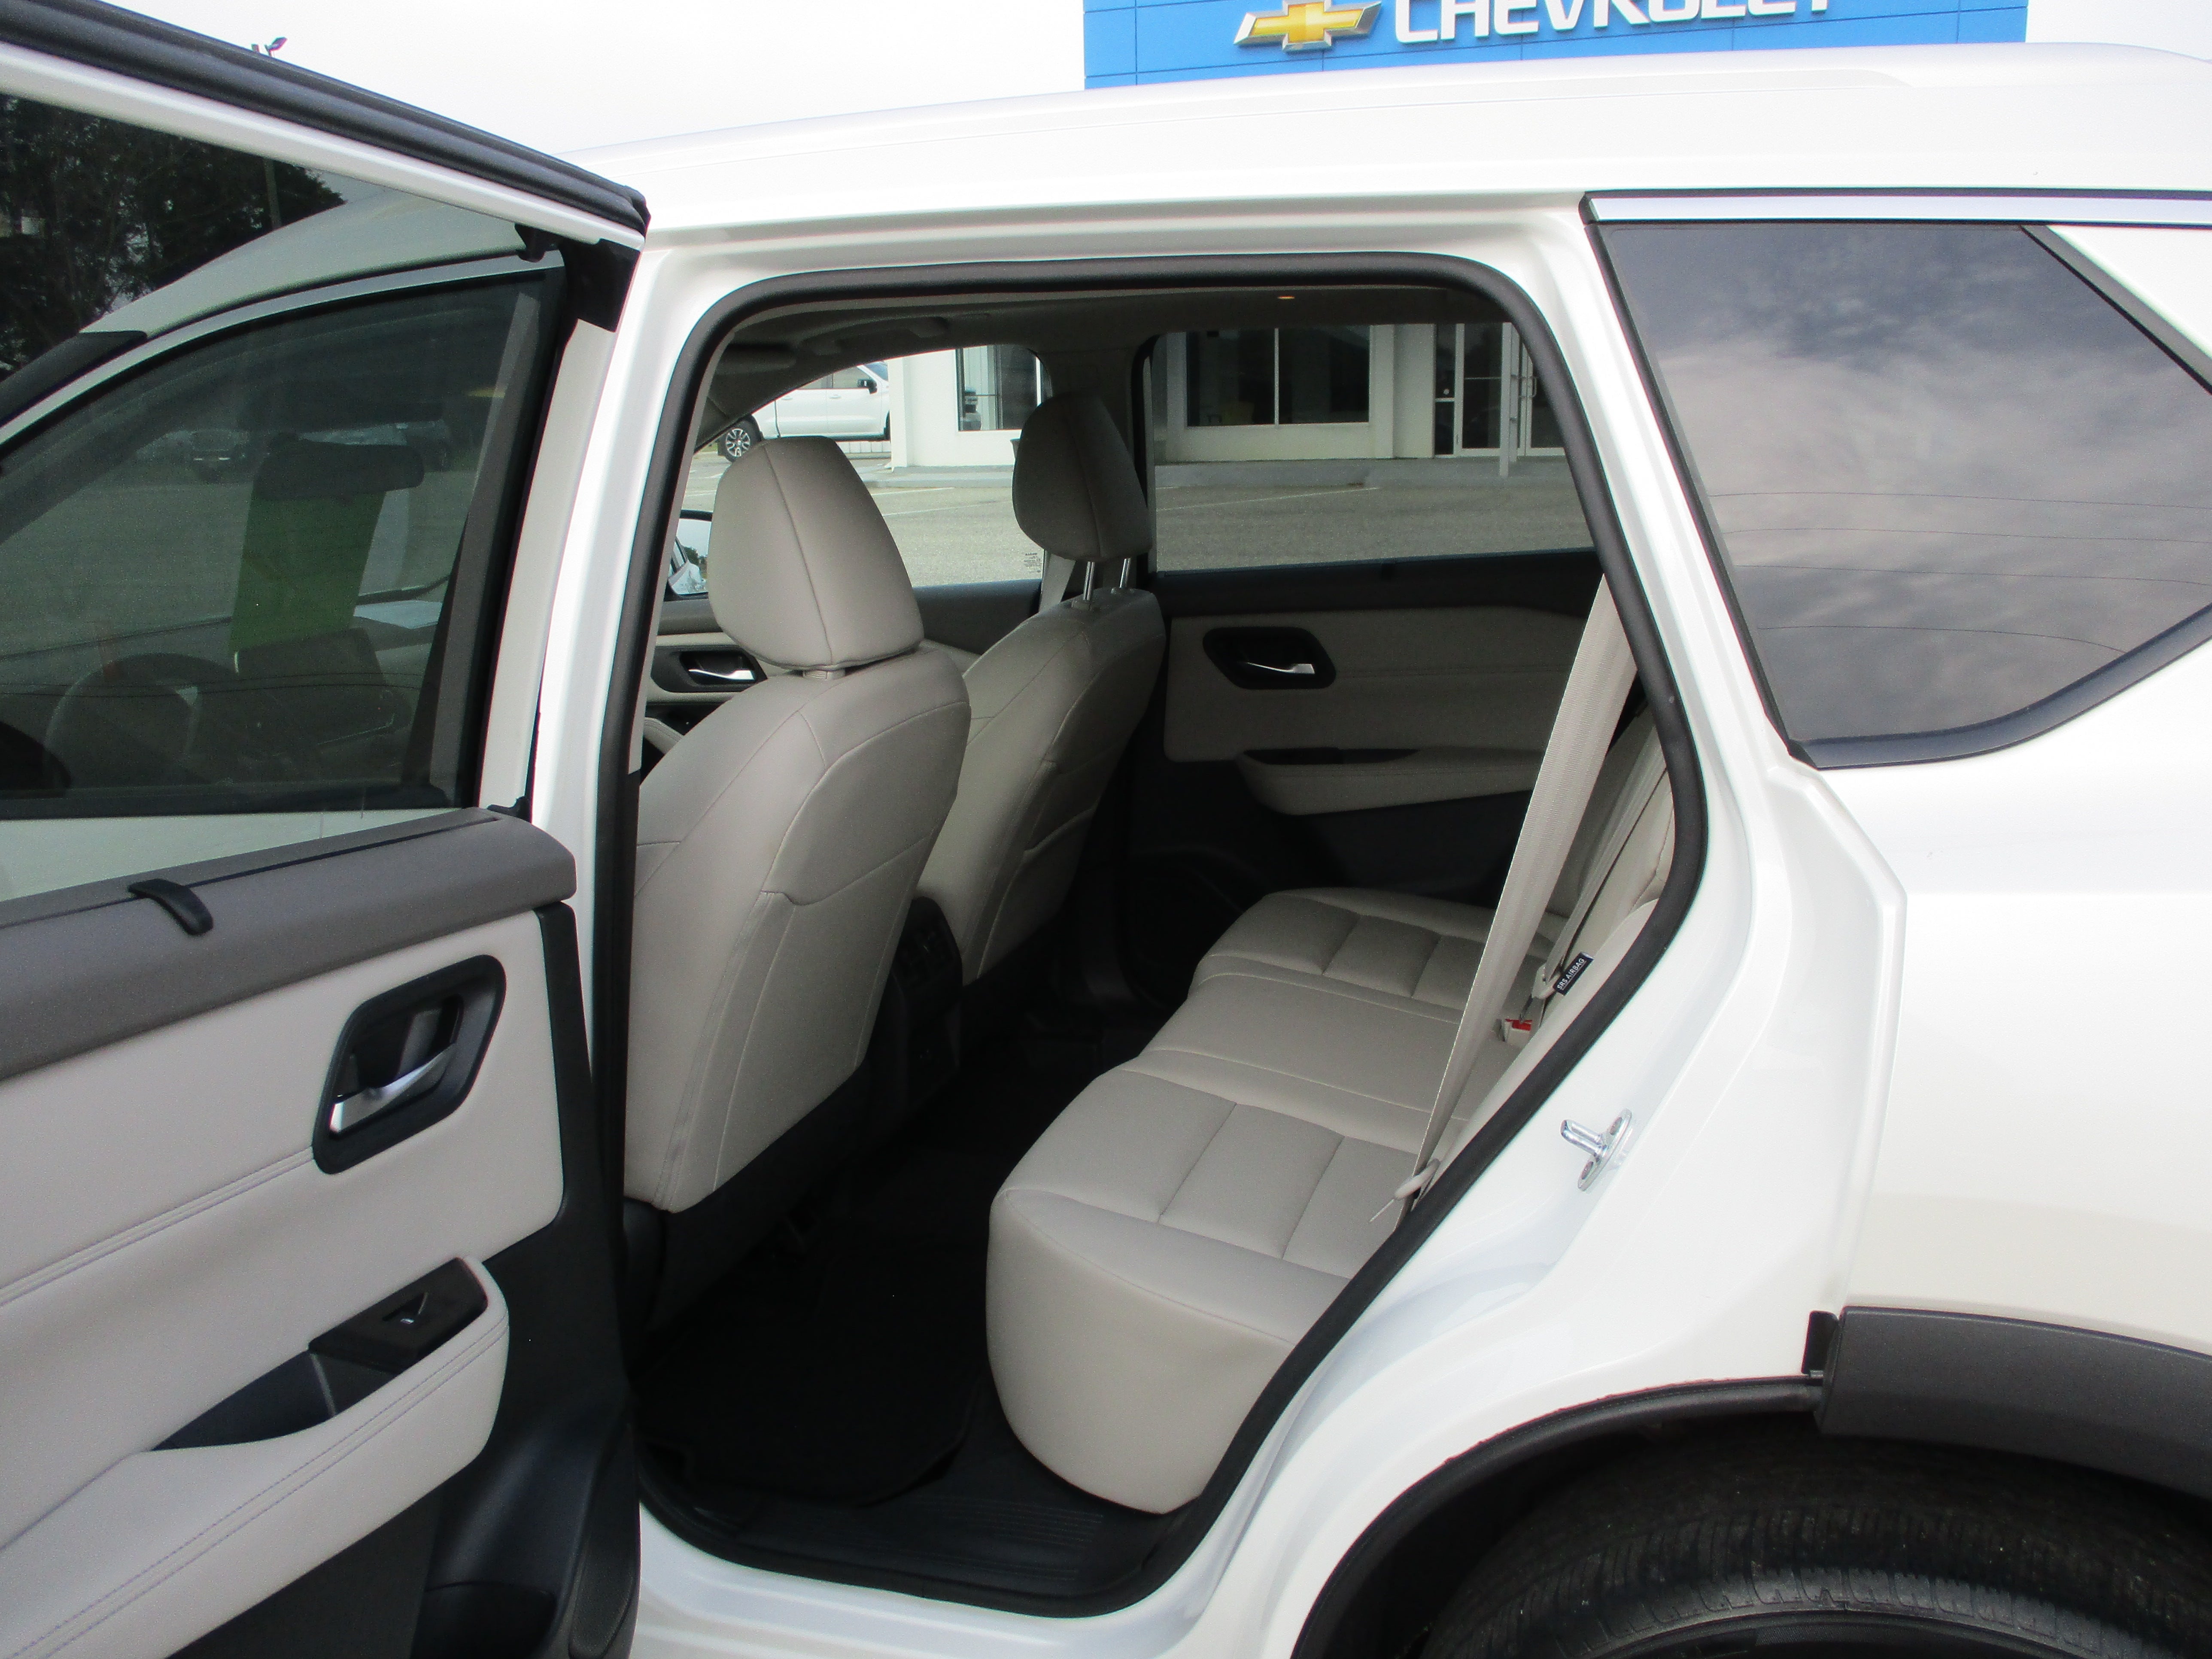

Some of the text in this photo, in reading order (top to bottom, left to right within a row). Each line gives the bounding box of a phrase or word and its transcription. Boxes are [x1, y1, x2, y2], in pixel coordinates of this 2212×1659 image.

[1395, 0, 1828, 43] CHEVR
[1557, 957, 1585, 990] SRS AIRBAG
